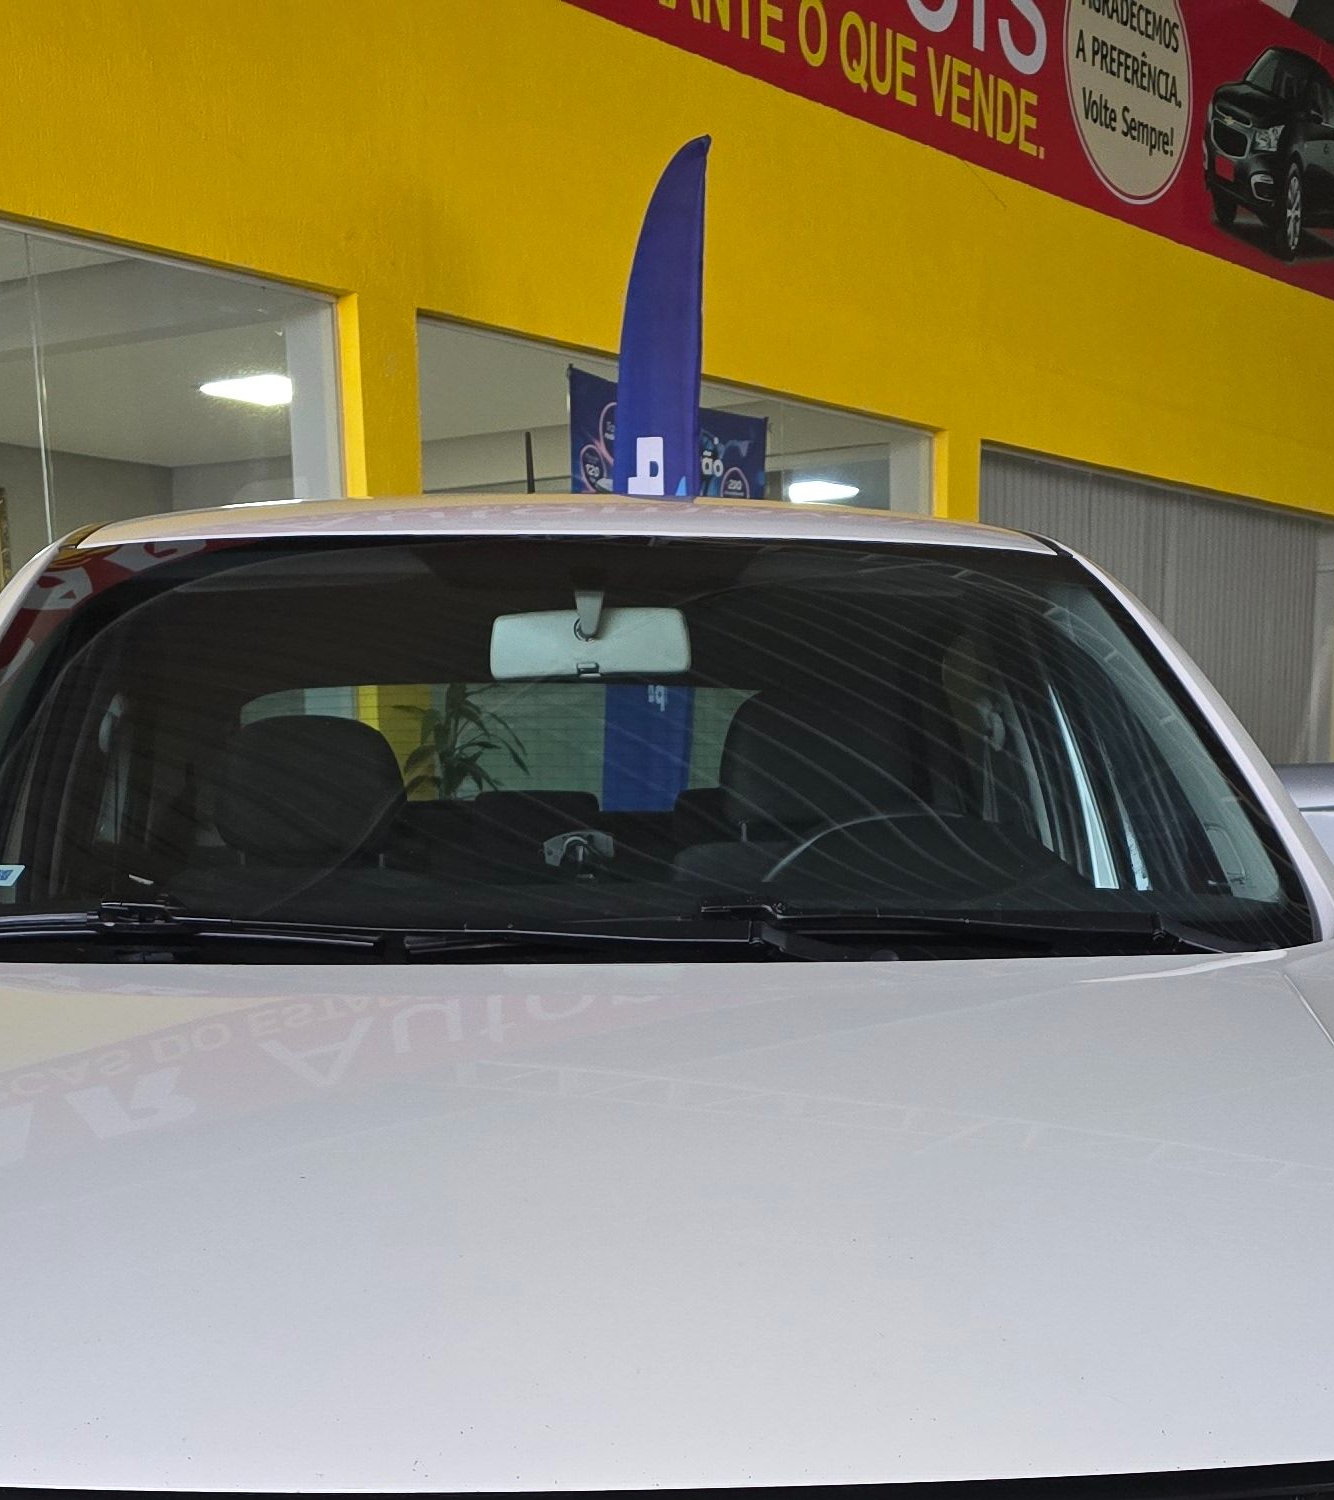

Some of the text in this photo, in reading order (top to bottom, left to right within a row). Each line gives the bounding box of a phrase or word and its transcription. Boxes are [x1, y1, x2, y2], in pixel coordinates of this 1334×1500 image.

[1076, 29, 1086, 62] A
[1081, 0, 1179, 53] RADECEMOS
[839, 11, 917, 107] QUE
[927, 47, 1045, 159] VENDE.
[1082, 87, 1174, 157] Volte Sempre!
